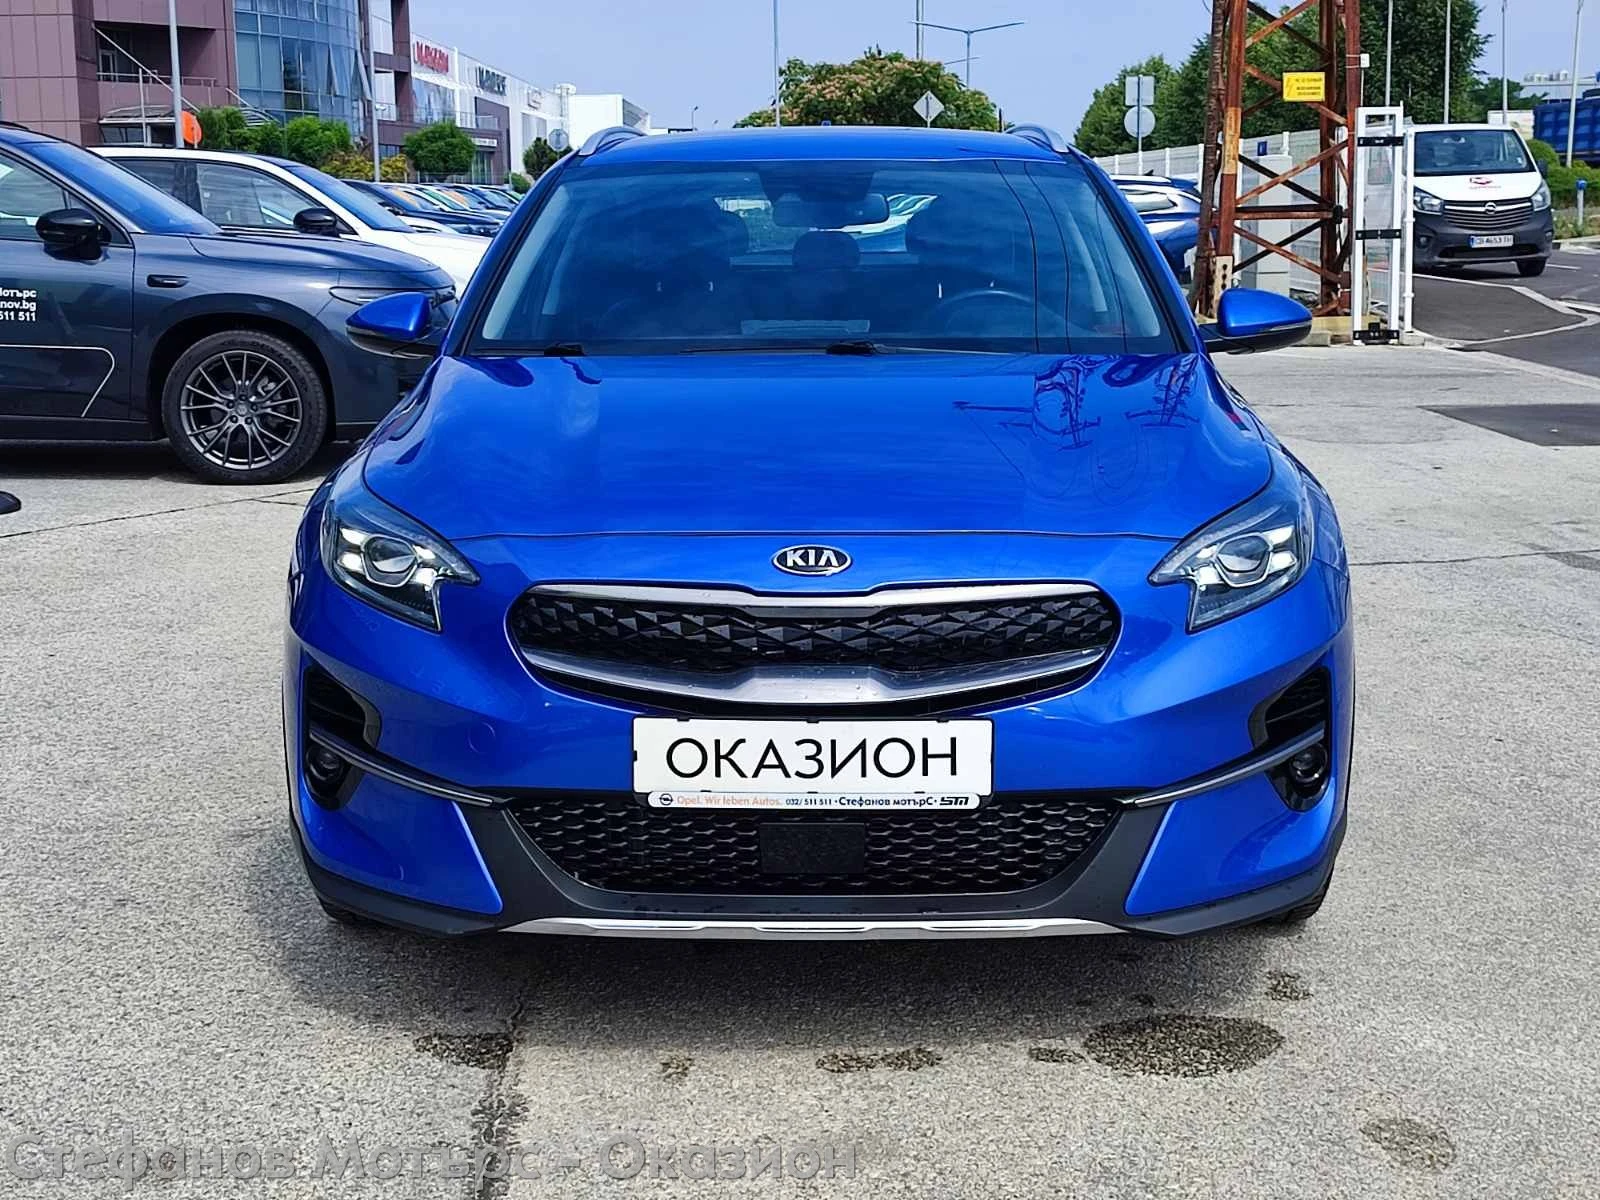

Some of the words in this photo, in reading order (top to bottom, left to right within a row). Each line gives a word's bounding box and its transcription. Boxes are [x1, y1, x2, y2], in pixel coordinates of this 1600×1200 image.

[18, 312, 36, 321] 511
[786, 549, 839, 567] KIA
[666, 737, 957, 779] ОКАЗИОН
[704, 795, 721, 805] Wir
[723, 795, 750, 806] leben
[804, 798, 817, 806] 511
[819, 798, 832, 806] 511
